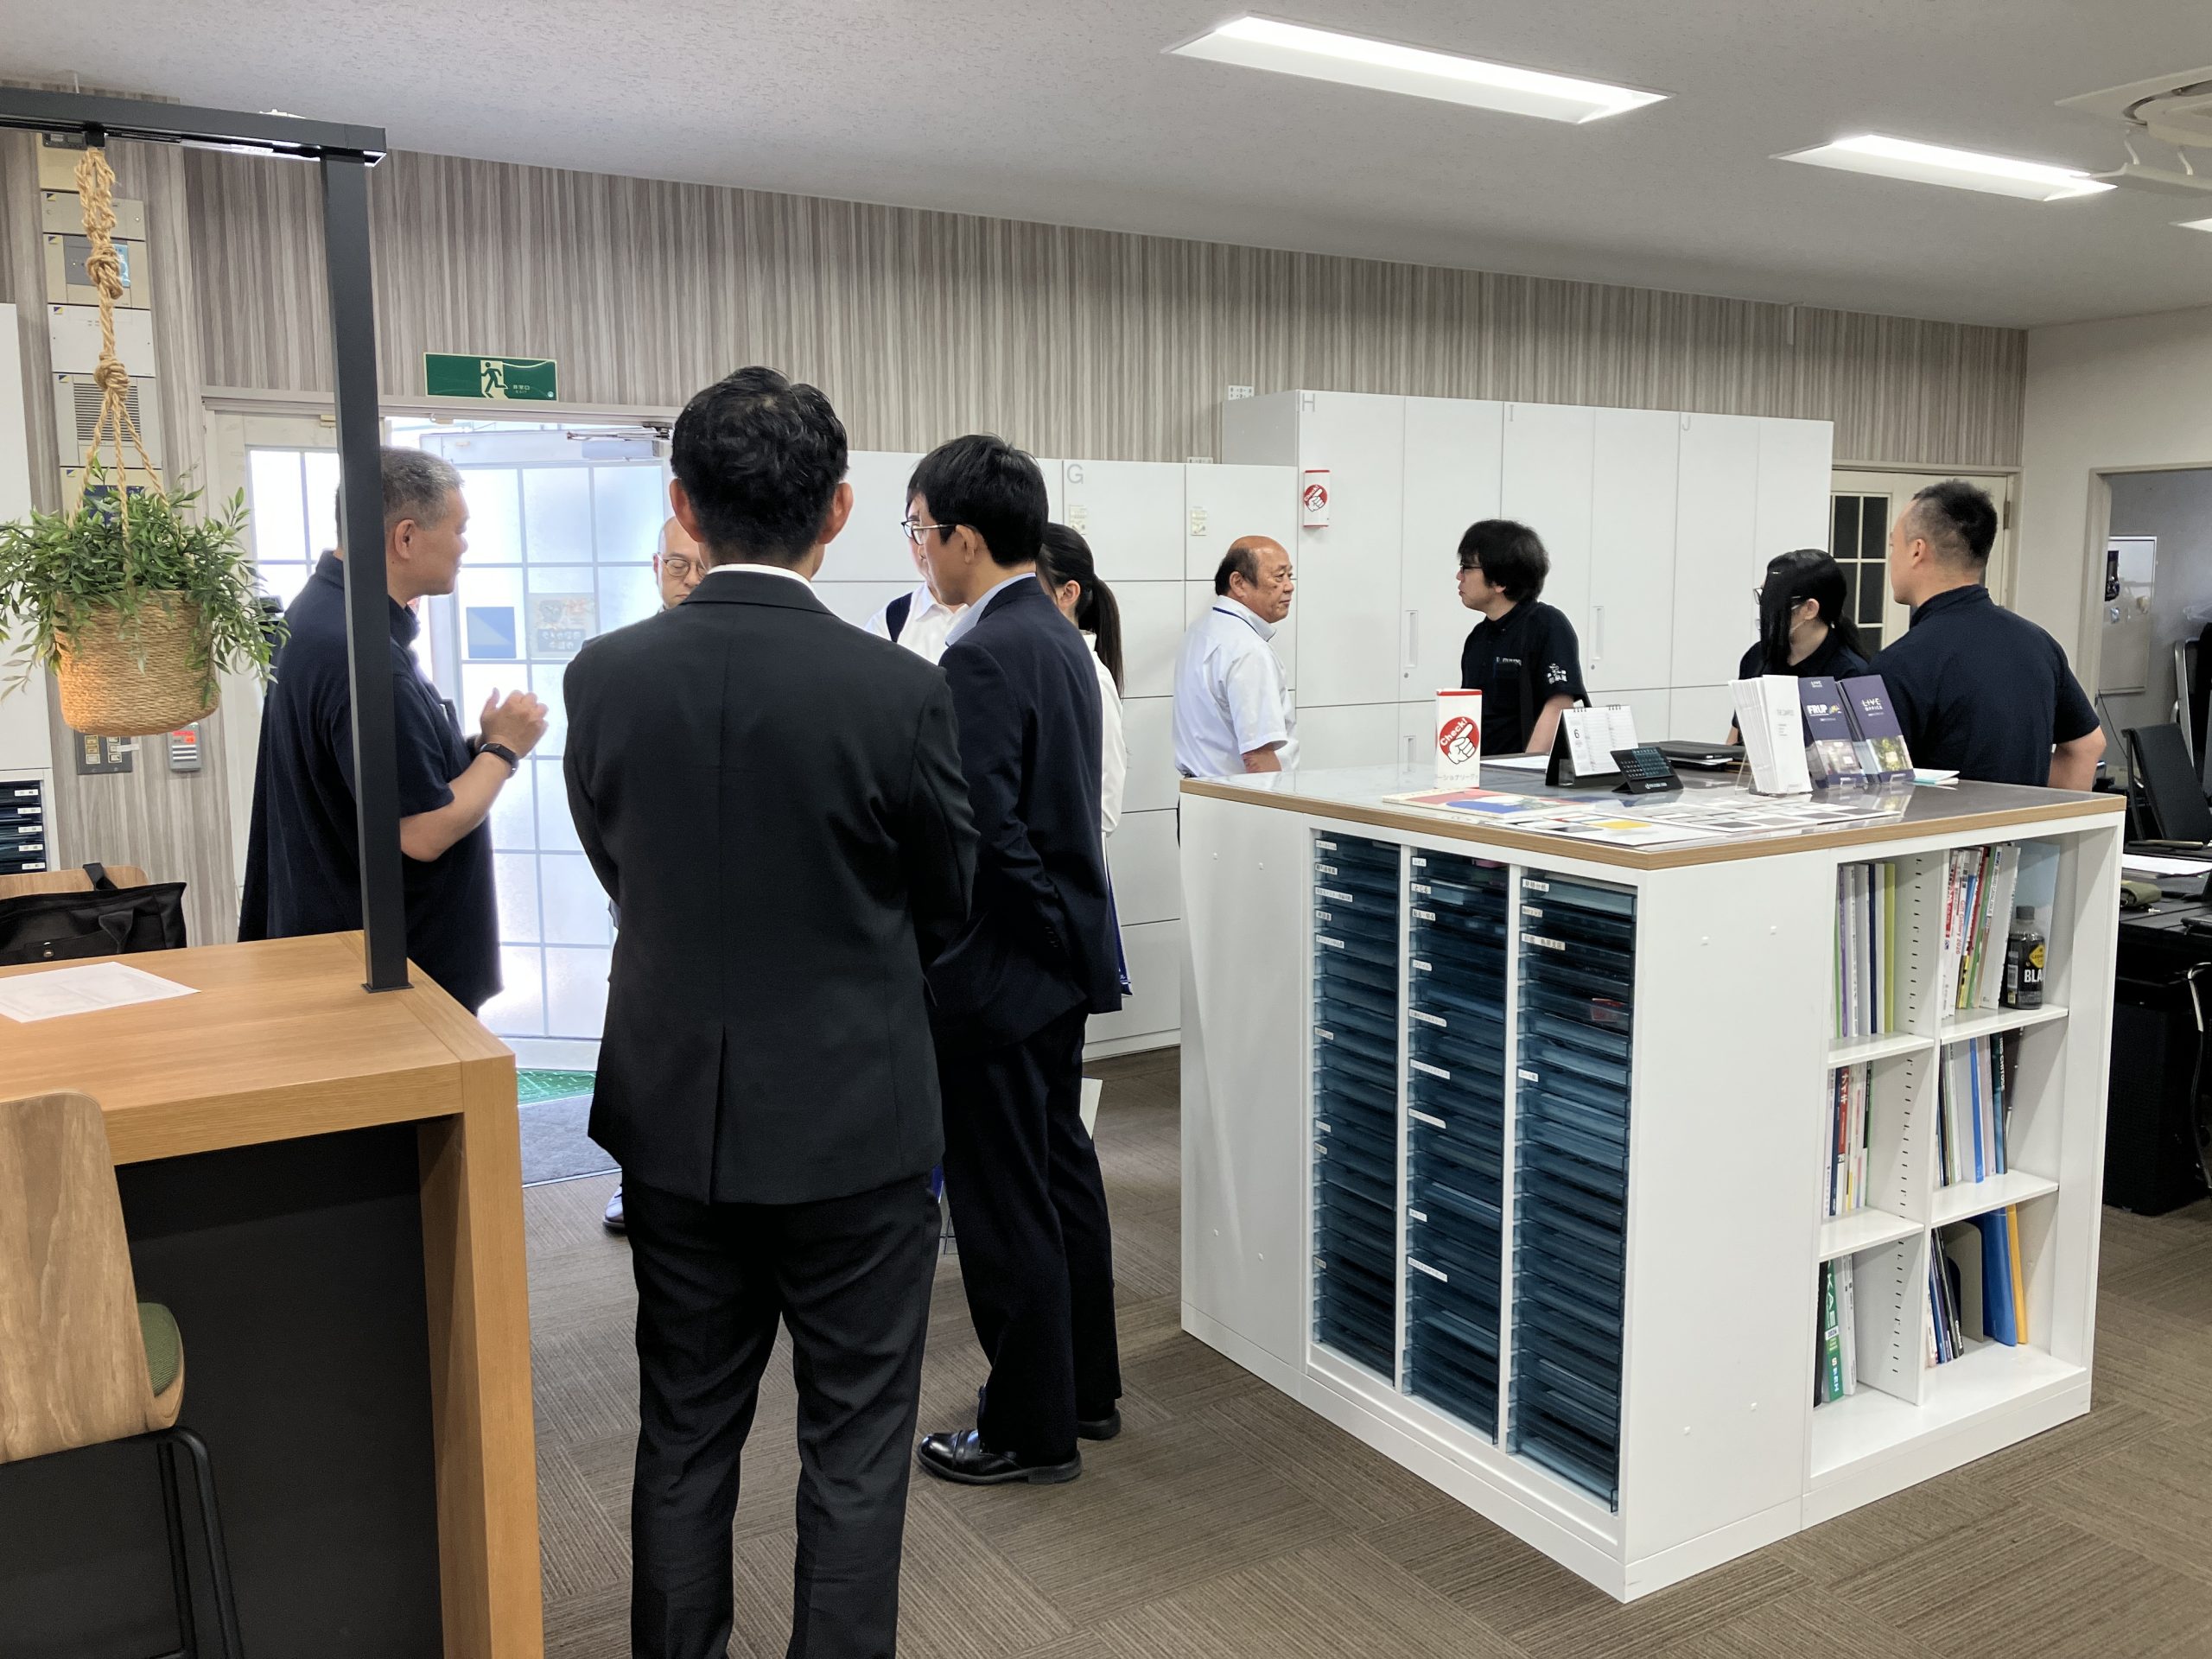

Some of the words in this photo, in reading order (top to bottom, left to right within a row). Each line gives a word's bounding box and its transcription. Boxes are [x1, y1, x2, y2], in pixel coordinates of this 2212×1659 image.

[1302, 393, 1315, 412] H
[1066, 463, 1084, 485] G
[1862, 698, 1881, 707] LIVE
[1440, 717, 1468, 746] Check!
[1573, 728, 1580, 739] 6
[2024, 969, 2044, 983] BLA
